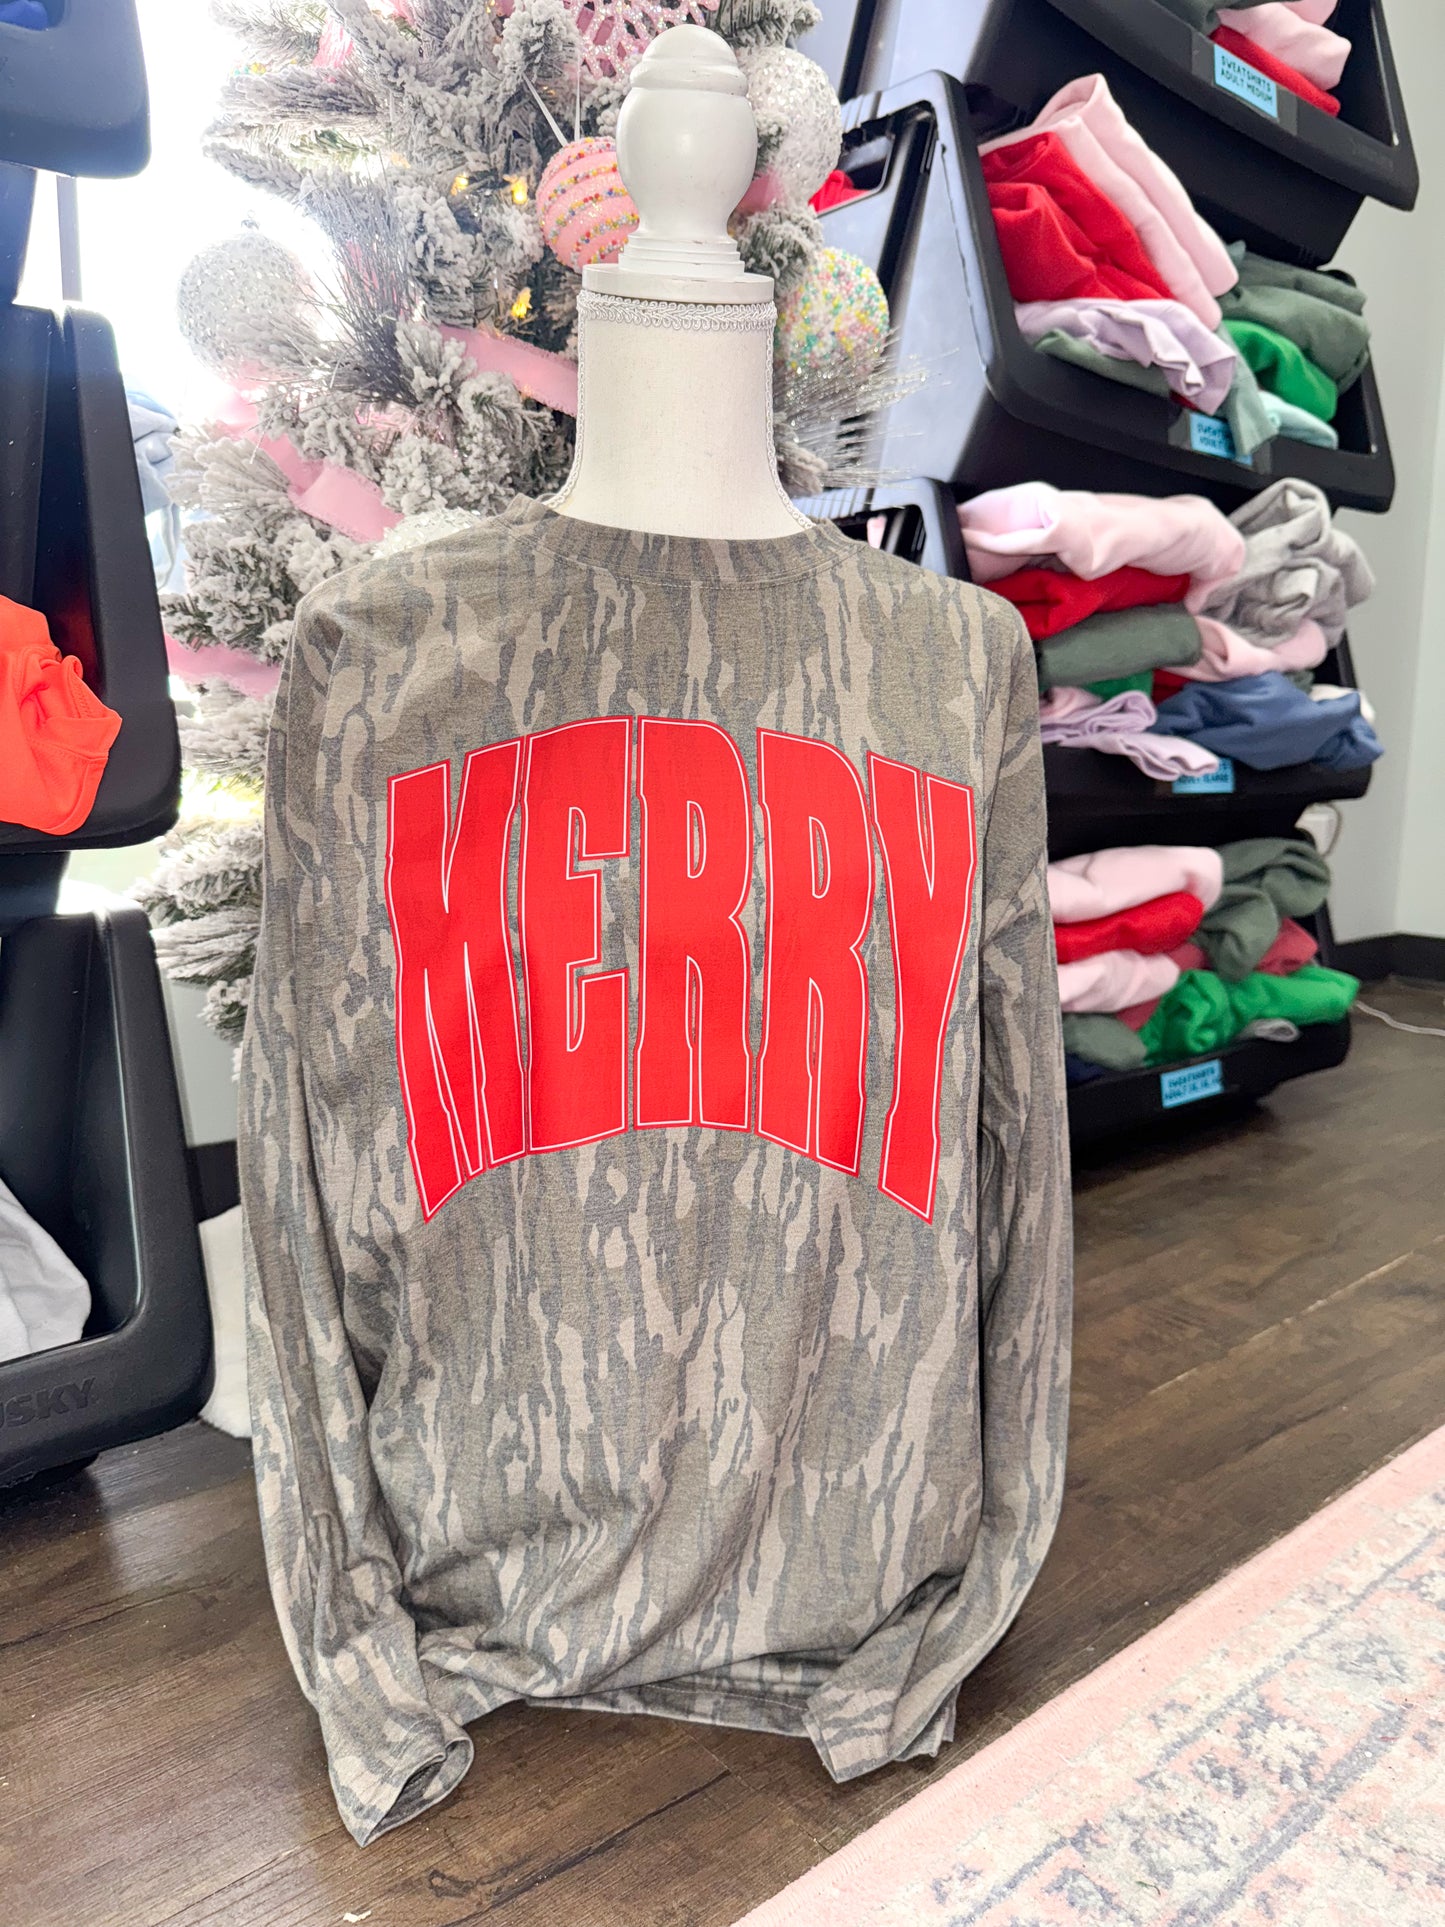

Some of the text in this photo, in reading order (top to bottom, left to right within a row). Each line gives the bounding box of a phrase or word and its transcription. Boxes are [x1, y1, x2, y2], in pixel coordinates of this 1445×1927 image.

[1221, 55, 1271, 92] SWEATSHIRTS
[385, 714, 976, 1225] MERRY
[0, 1377, 95, 1428] SKY
